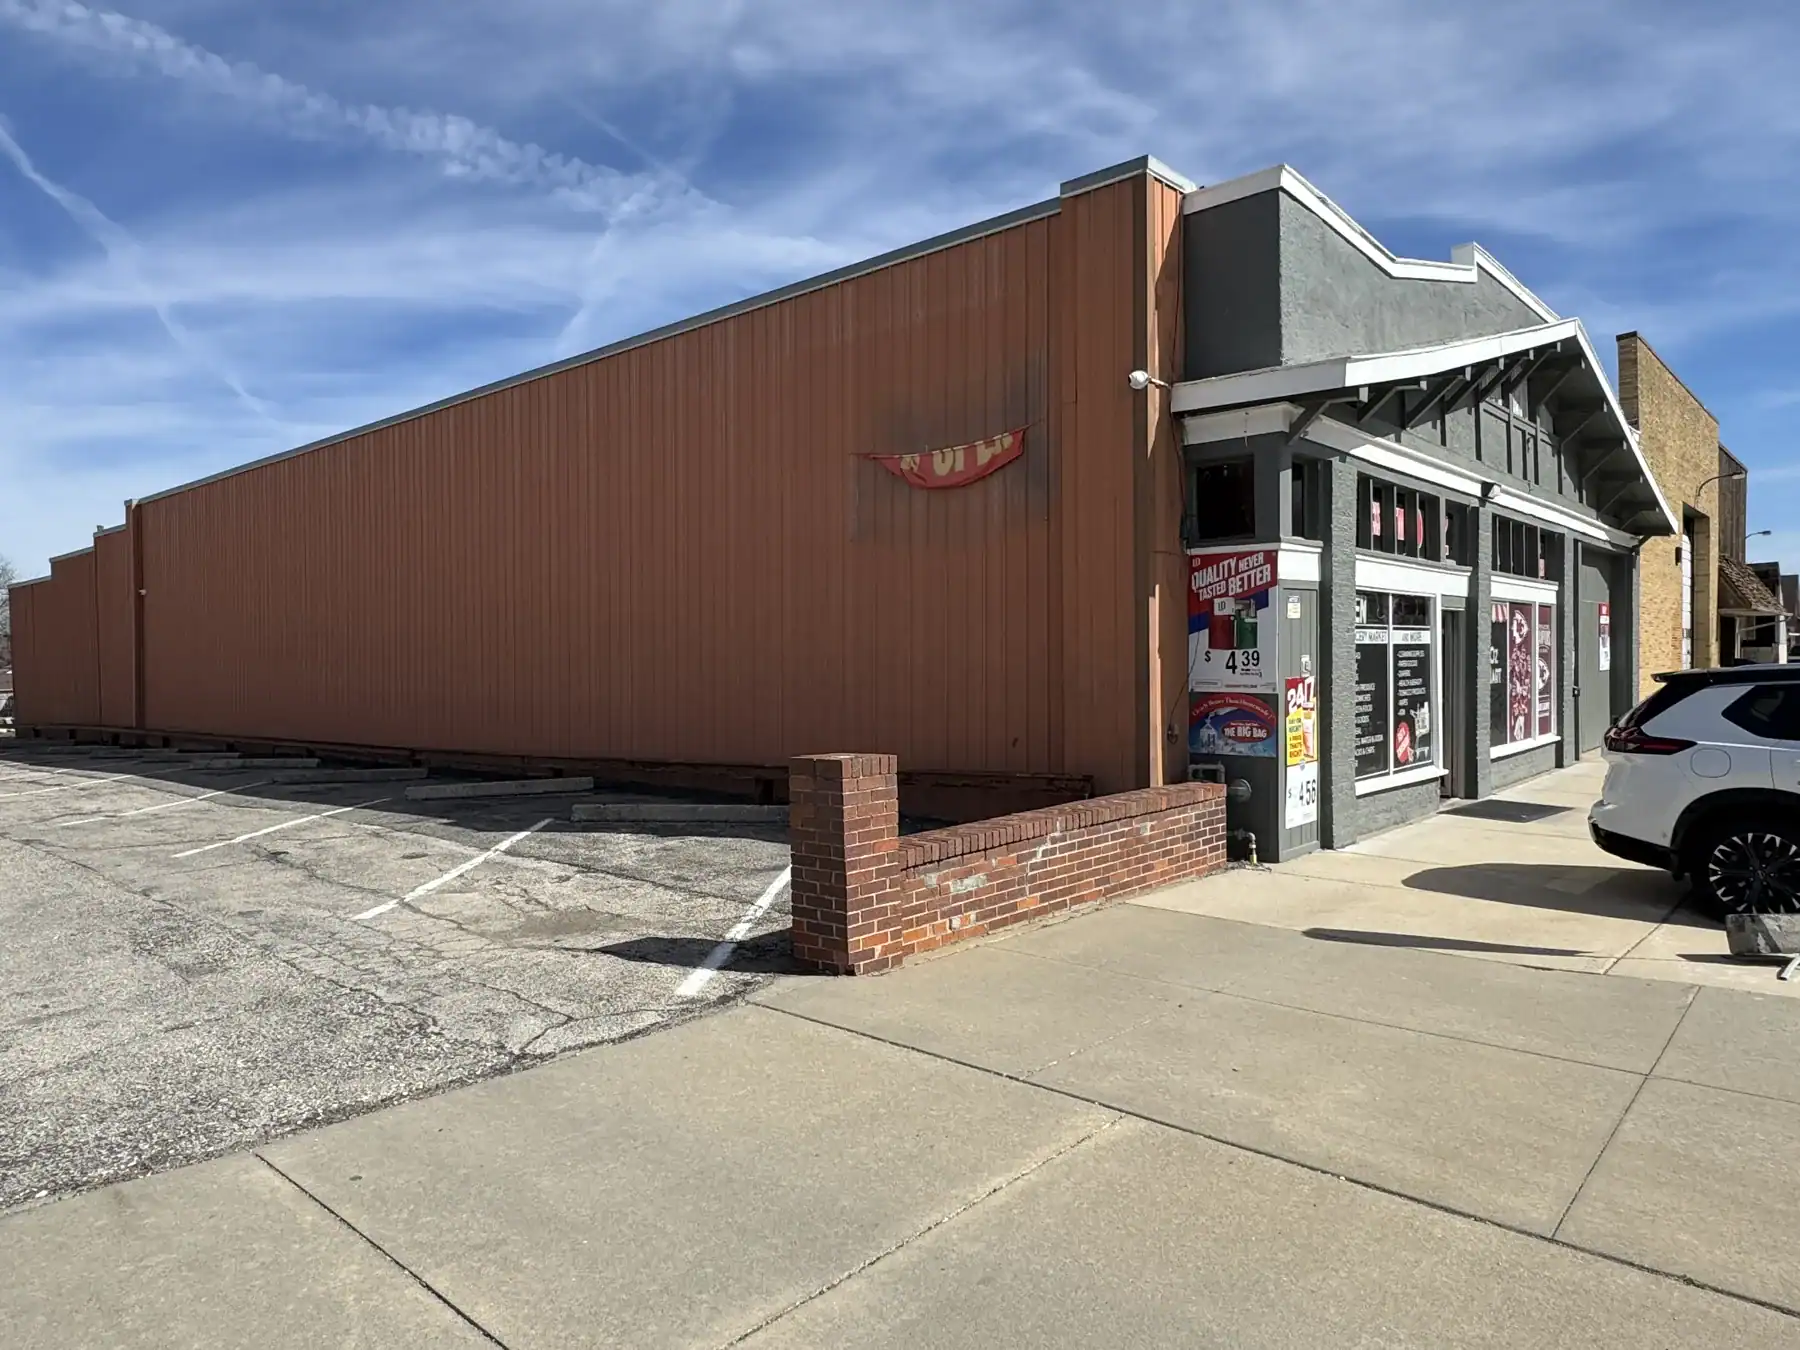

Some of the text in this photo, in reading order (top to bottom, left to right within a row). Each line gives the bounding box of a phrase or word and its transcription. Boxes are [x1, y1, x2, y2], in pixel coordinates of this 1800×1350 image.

[1191, 552, 1264, 593] QUALITY NEVER
[1199, 563, 1271, 602] TASTED BETTER
[1224, 726, 1268, 738] THE BIG BAG
